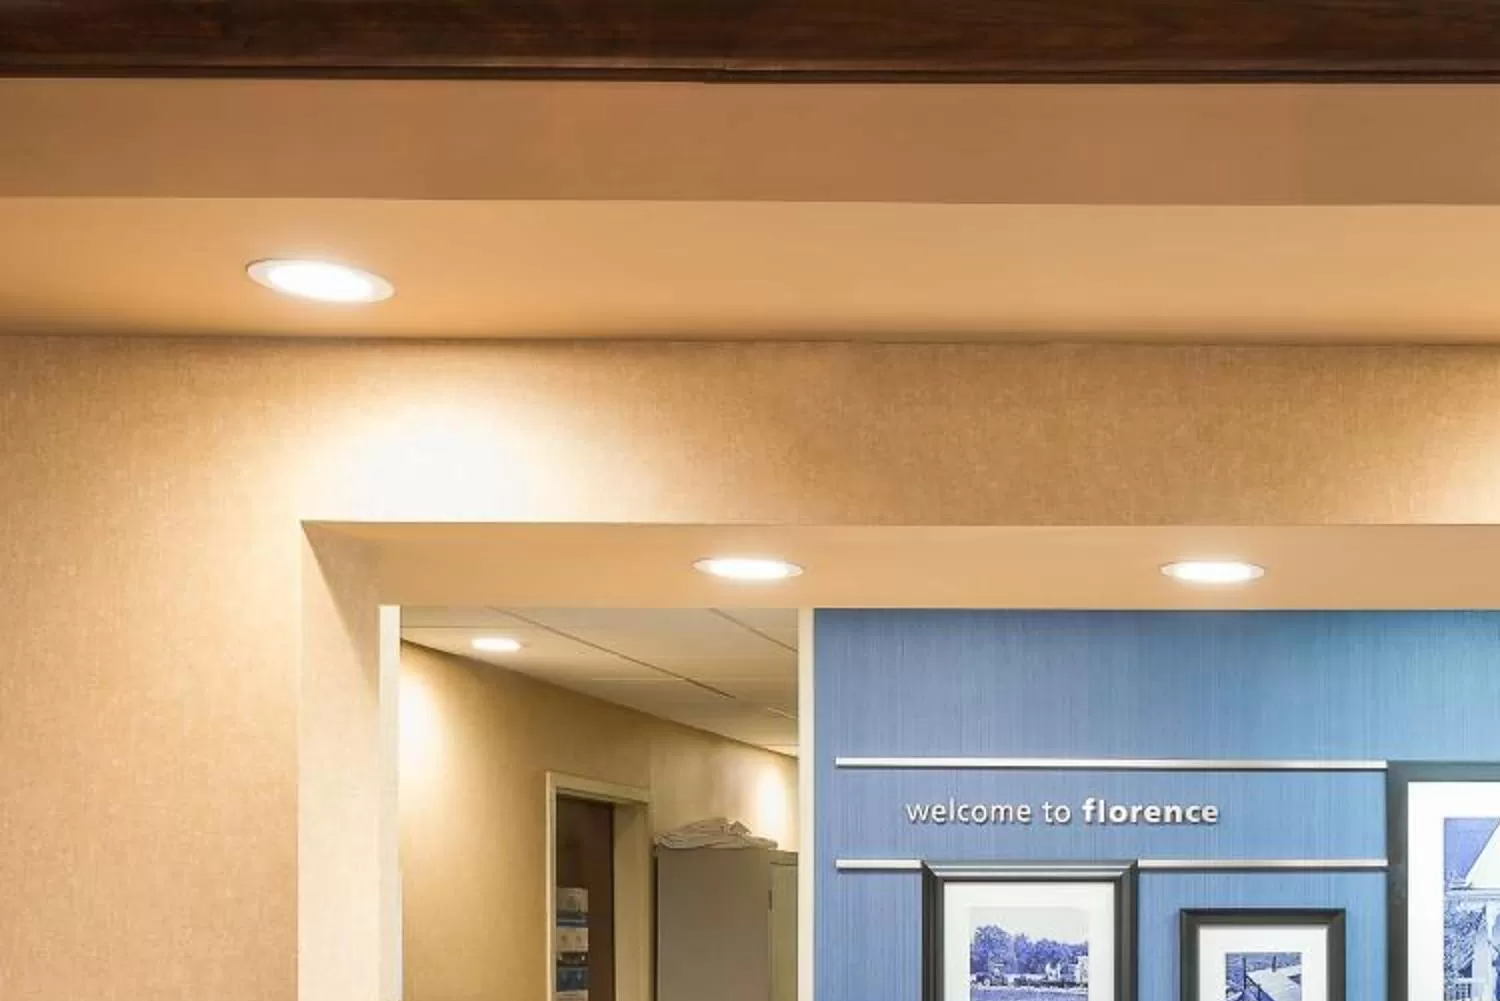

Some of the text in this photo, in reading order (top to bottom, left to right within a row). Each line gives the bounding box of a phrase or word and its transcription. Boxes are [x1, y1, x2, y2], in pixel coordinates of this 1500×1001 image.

[906, 798, 1219, 823] welcome to florence
